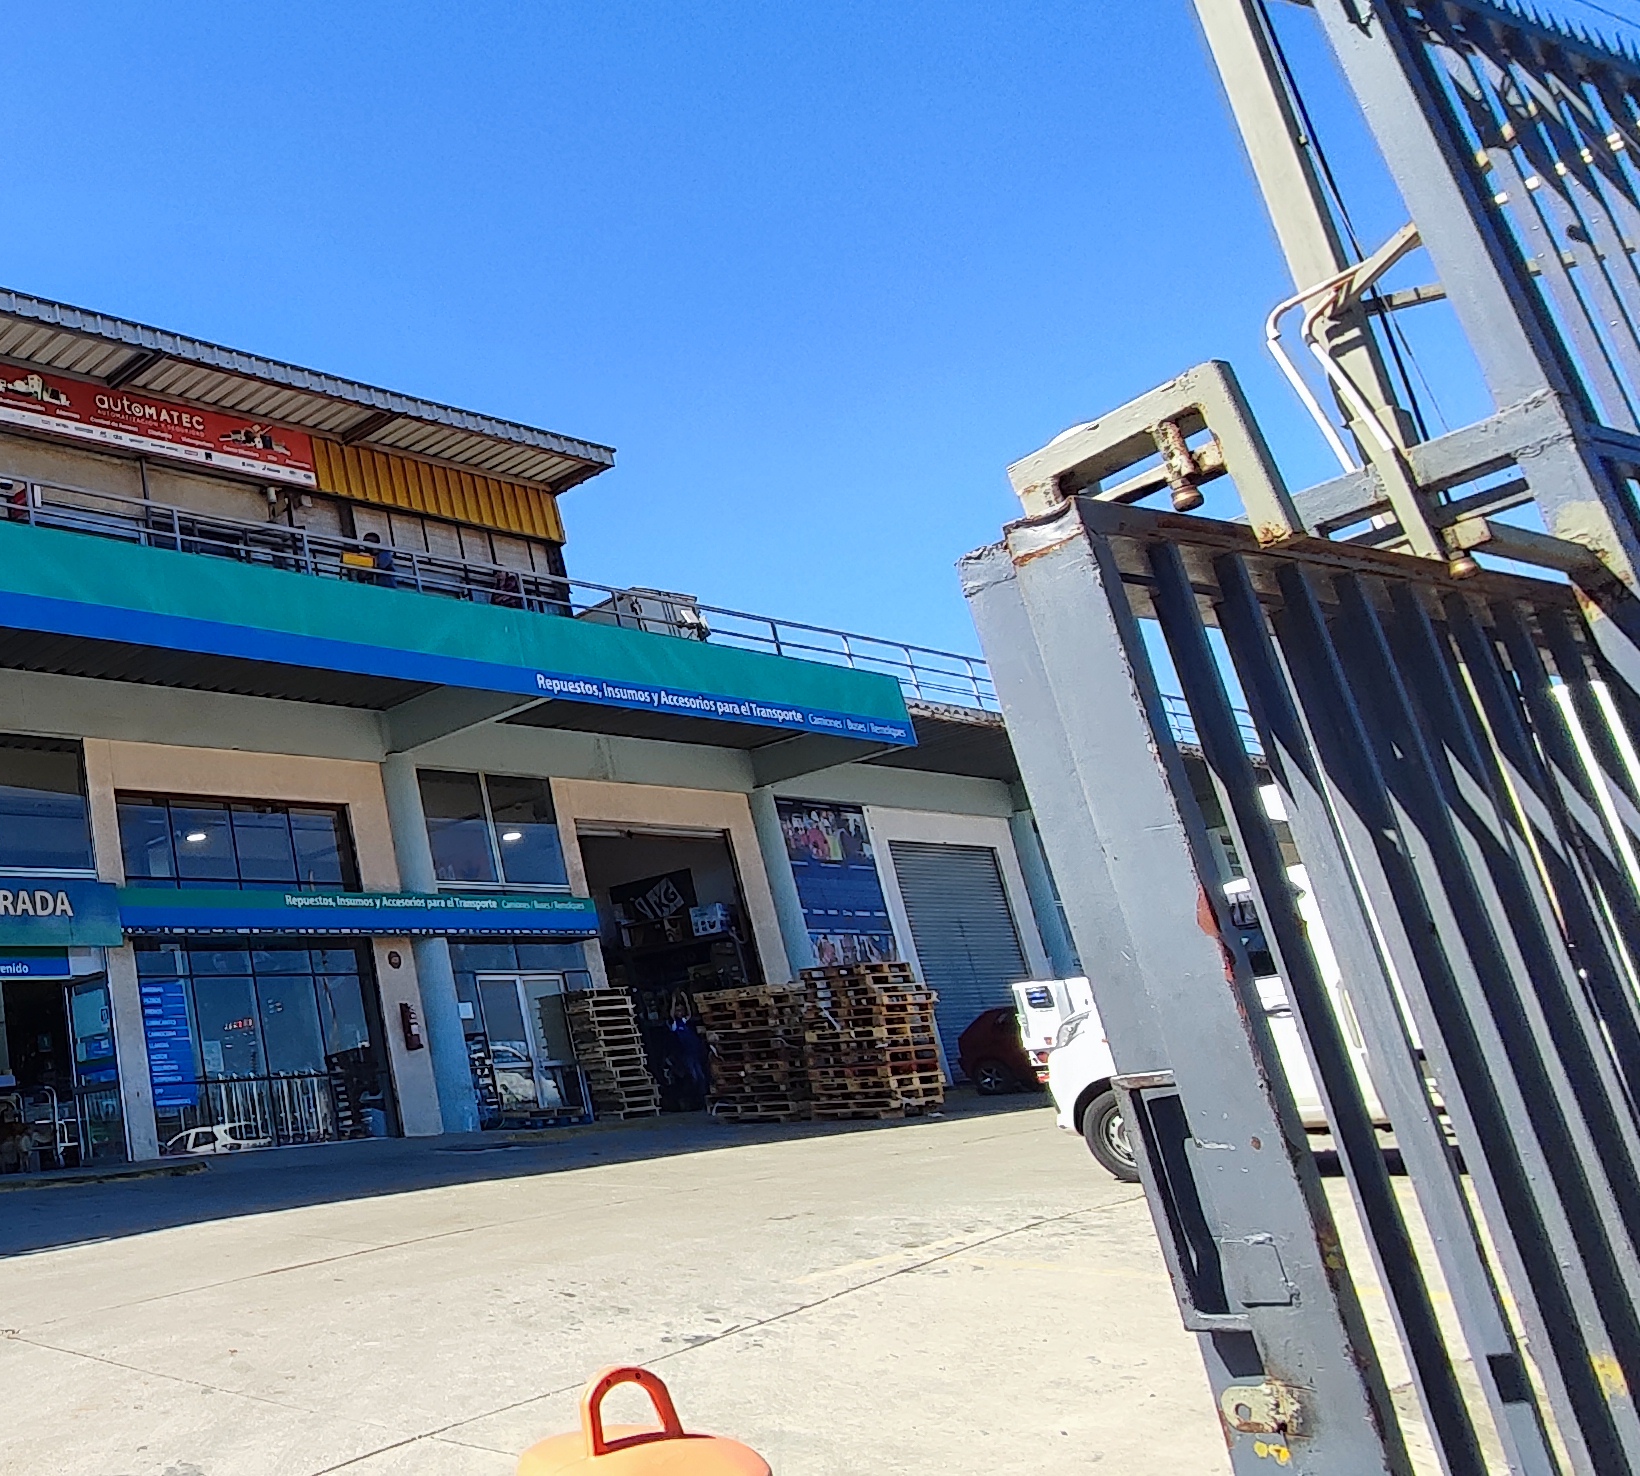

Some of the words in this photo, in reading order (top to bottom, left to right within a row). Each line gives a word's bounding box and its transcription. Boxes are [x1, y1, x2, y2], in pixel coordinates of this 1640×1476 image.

[536, 673, 603, 698] Repuestos,
[602, 683, 651, 703] Insumos
[651, 692, 659, 706] y
[660, 690, 716, 711] Accesorios
[716, 702, 740, 715] para
[740, 703, 751, 715] el
[751, 703, 804, 723] Transporte
[285, 895, 336, 908] Repuestos,
[336, 896, 374, 907] Insumos
[382, 897, 426, 908] Accesorios
[455, 897, 498, 910] Transporte
